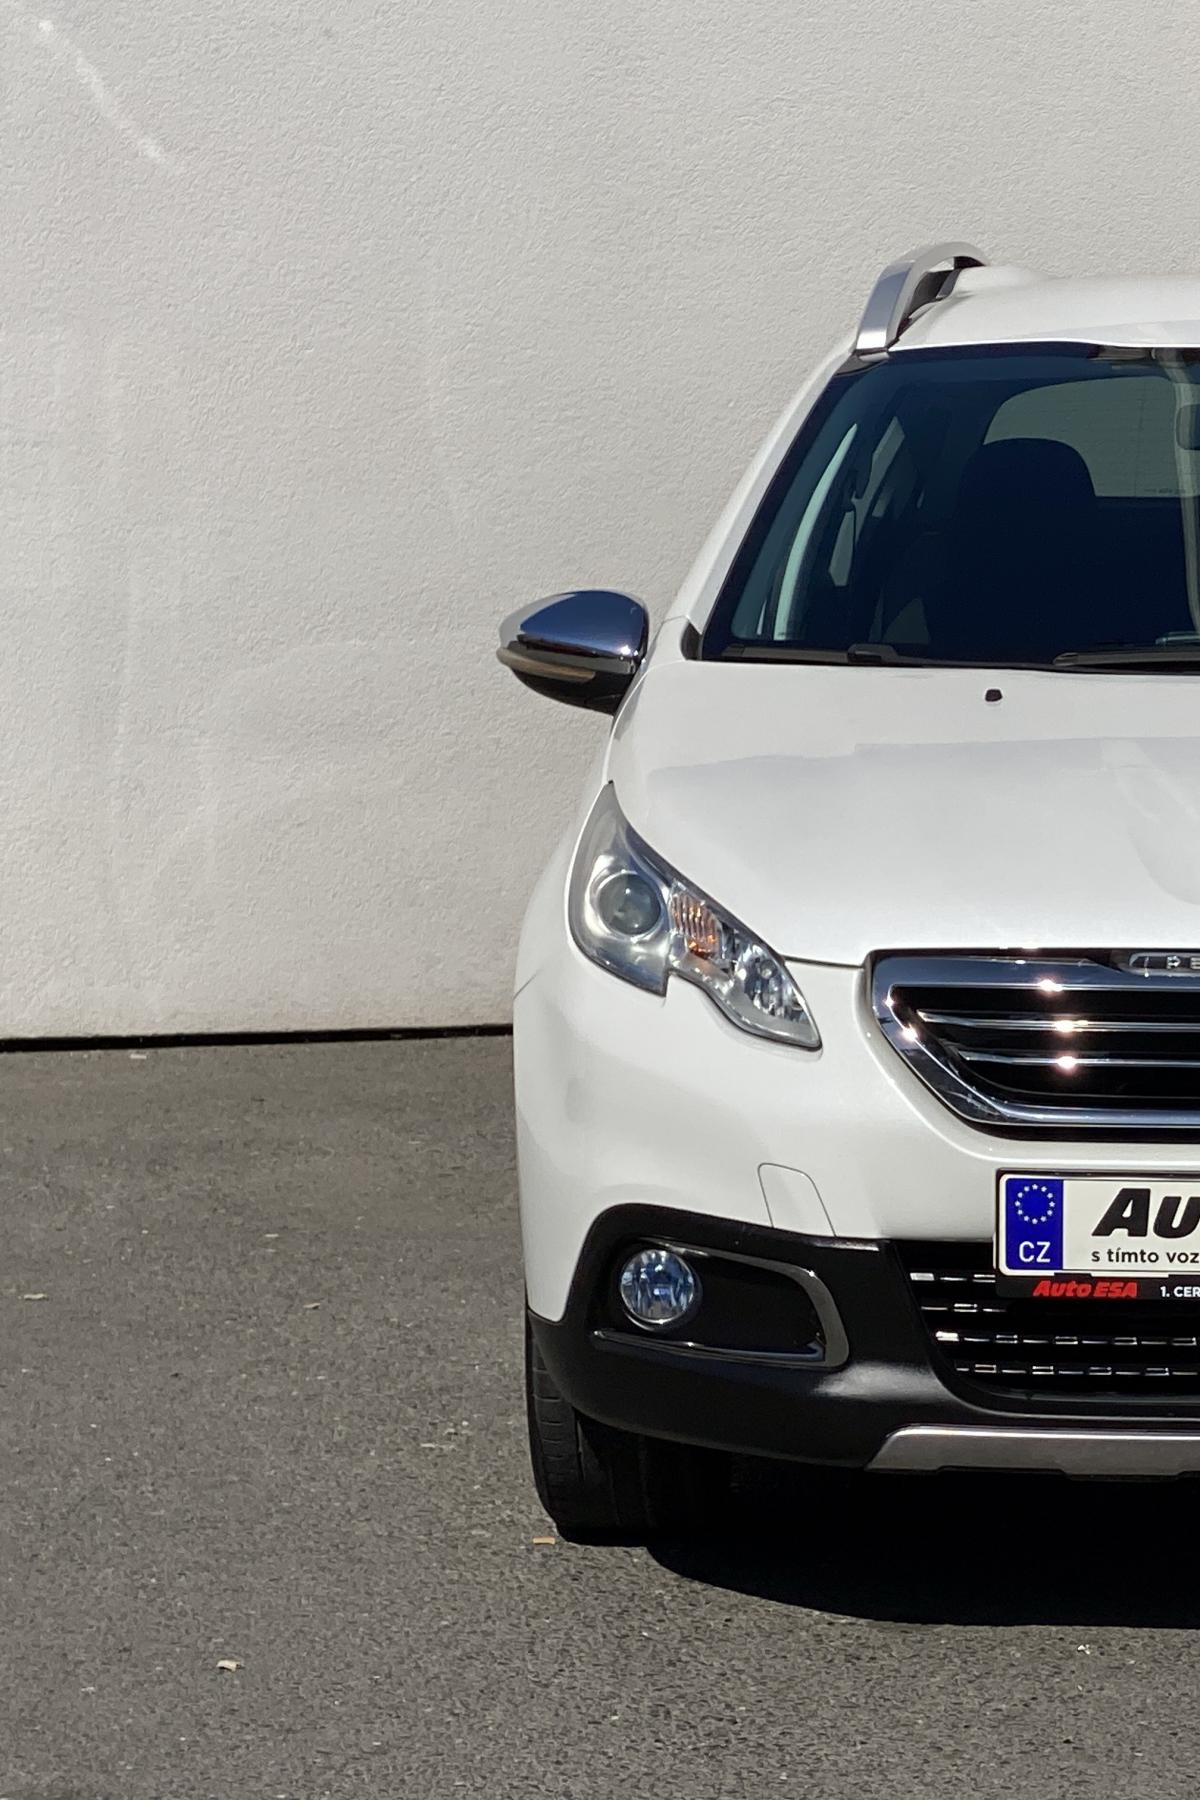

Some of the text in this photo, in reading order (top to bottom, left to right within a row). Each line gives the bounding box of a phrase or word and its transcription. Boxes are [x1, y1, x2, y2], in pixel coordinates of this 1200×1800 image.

[1019, 1241, 1051, 1263] CZ
[1091, 1251, 1100, 1263] s
[1107, 1247, 1159, 1264] tímto
[1033, 1281, 1138, 1297] Auto ESA
[1160, 1286, 1170, 1297] 1.
